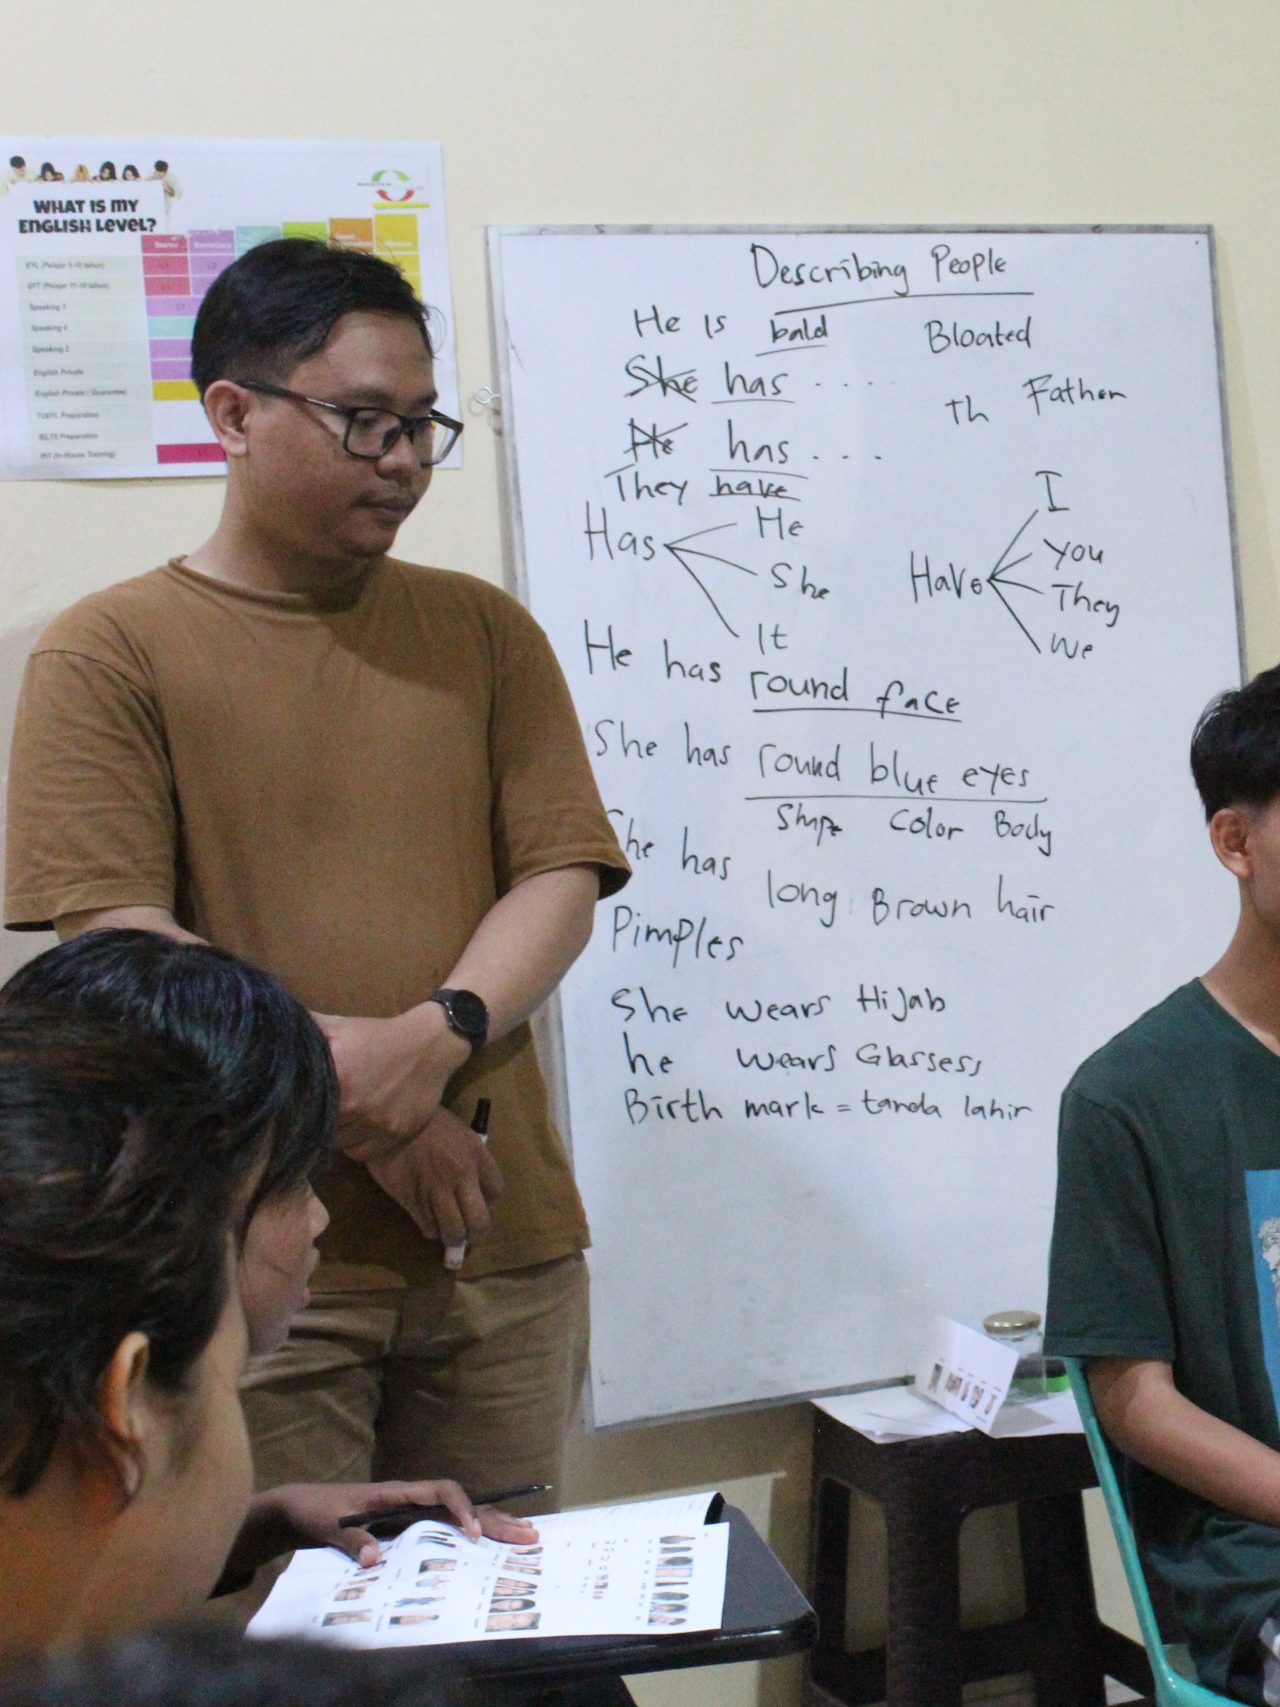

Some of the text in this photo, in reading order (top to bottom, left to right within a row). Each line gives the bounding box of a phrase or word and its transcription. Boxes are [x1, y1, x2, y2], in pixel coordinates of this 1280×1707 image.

[33, 199, 85, 214] WHAT
[90, 199, 106, 213] IS
[750, 243, 1007, 297] Describing People
[634, 304, 681, 339] He
[770, 314, 828, 345] bald
[924, 316, 1032, 354] Bloated
[724, 361, 789, 397] has
[727, 418, 790, 464] has
[604, 463, 789, 506] They have
[1035, 471, 1070, 512] I
[584, 501, 656, 561] Has
[756, 506, 804, 540] He
[772, 562, 830, 600] She
[1050, 583, 1121, 628] They
[757, 622, 789, 651] It
[584, 619, 962, 720] He has round face
[594, 719, 1031, 796] She has round blue eyes
[607, 808, 732, 881] he has
[994, 809, 1053, 857] Body
[767, 869, 1055, 928] long Brown hair
[611, 905, 744, 969] Pimples
[610, 986, 688, 1023] She
[726, 994, 831, 1023] wears
[622, 1031, 675, 1077] he
[736, 1043, 838, 1073] wears
[624, 1088, 723, 1125] Birth
[745, 1092, 826, 1120] mark
[861, 1088, 943, 1119] tanda
[963, 1095, 1033, 1121] lahir
